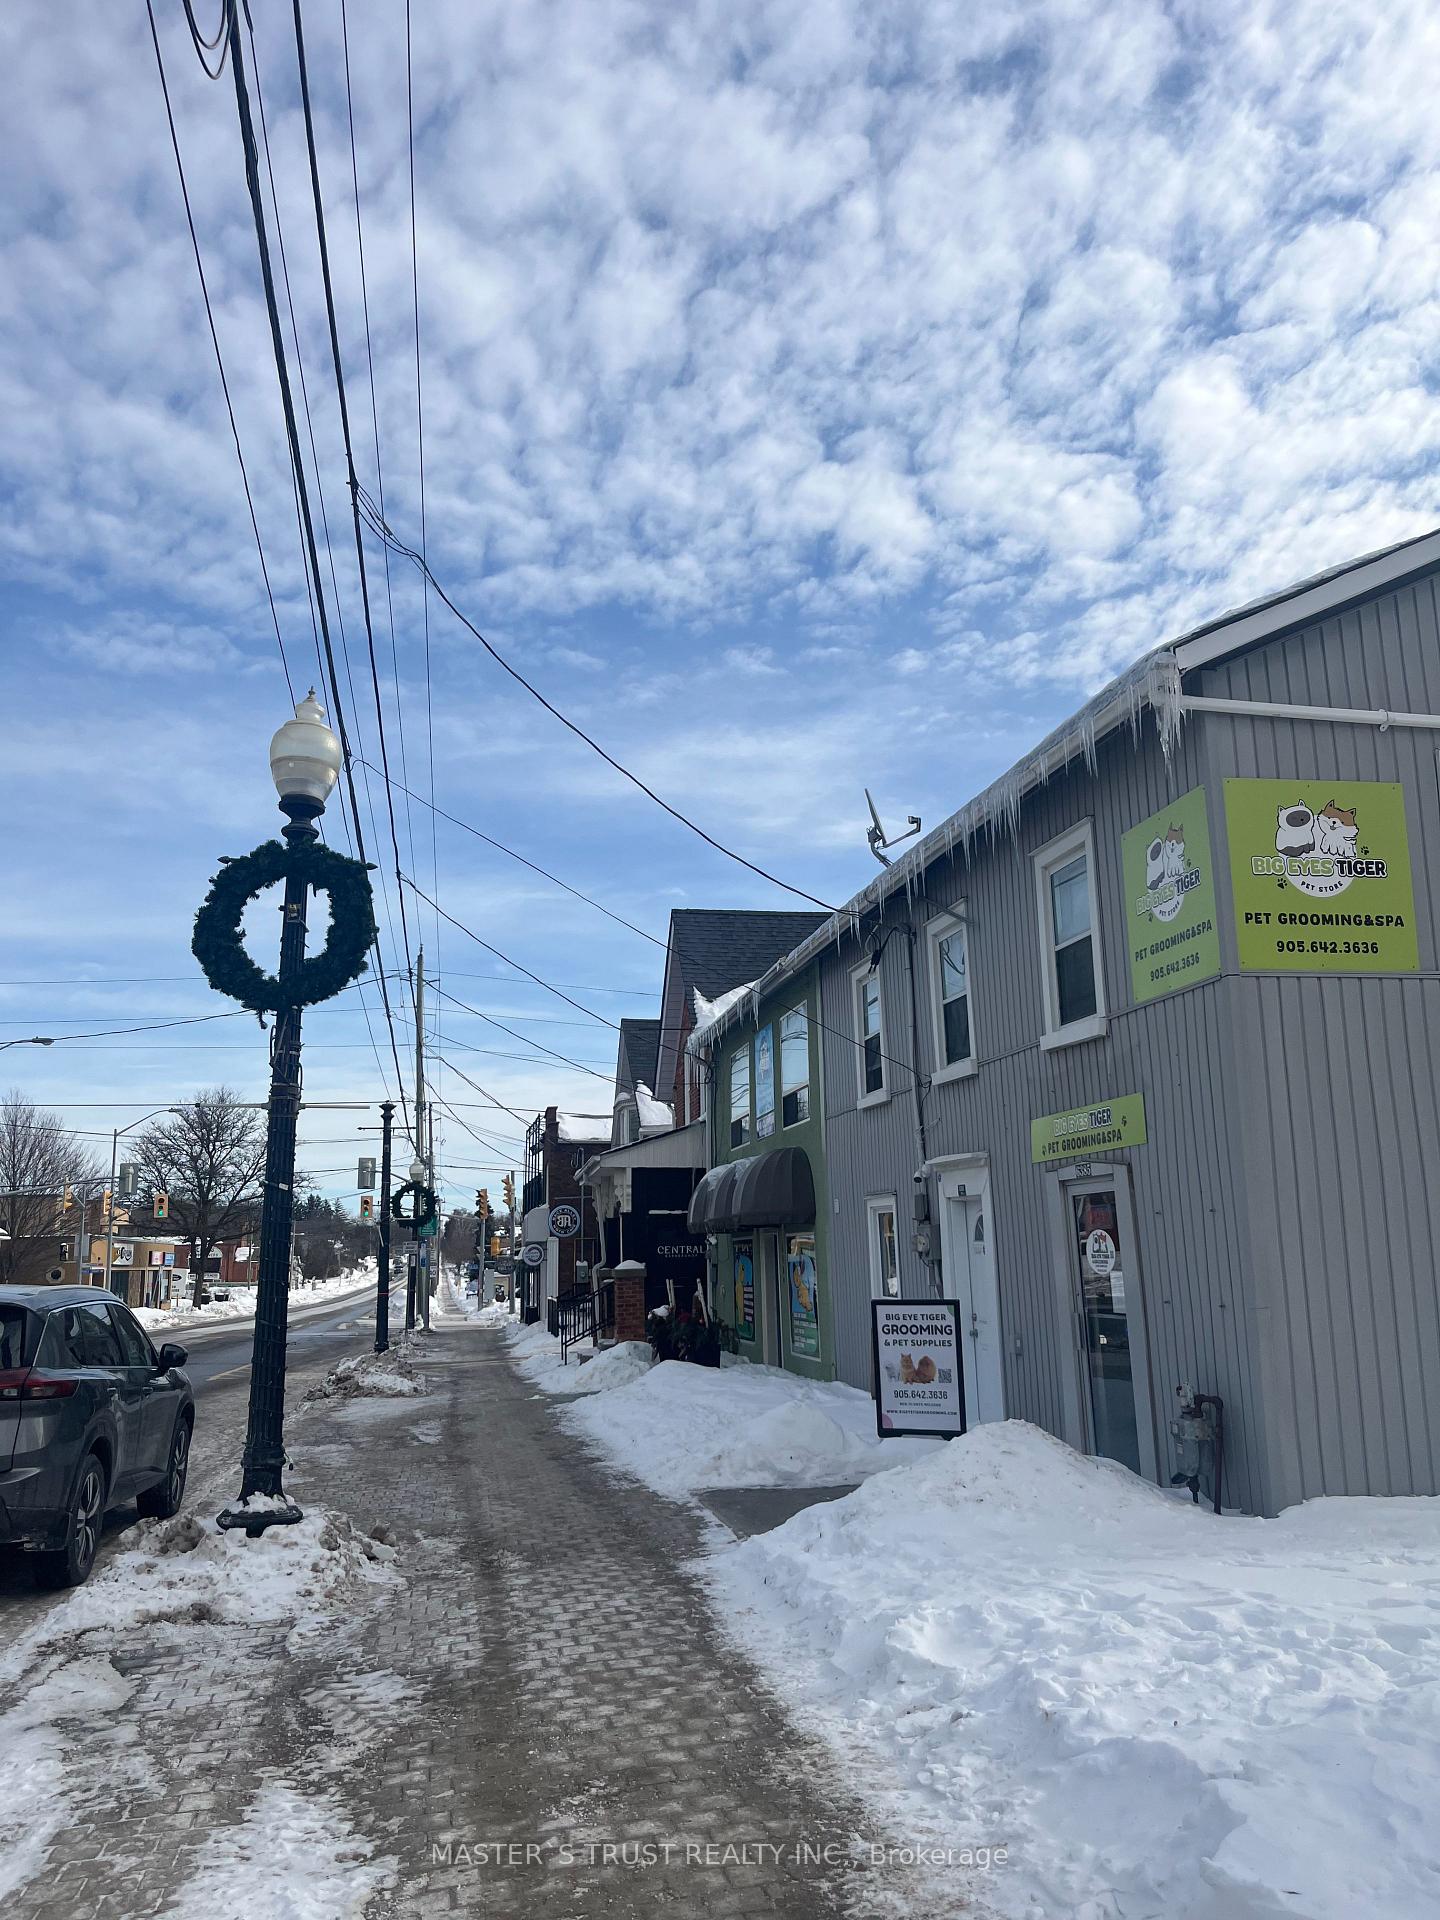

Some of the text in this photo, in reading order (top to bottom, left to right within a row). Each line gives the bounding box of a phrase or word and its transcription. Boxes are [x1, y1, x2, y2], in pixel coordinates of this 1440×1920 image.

[1252, 857, 1387, 878] BIG EYES TIGER
[1136, 867, 1201, 916] BIG EYES TIGER
[1301, 881, 1344, 892] PET STORE
[1245, 913, 1404, 927] PET GROOMING&SPA
[1135, 920, 1213, 962] PET GROOMING&SPA
[1276, 940, 1379, 954] 905.642.3636
[1150, 952, 1200, 982] 905.642.3636
[1054, 1107, 1112, 1137] BIG EYES TIGER
[1048, 1129, 1122, 1154] PET GROOMING&SPA
[657, 1245, 705, 1254] CENTRAL
[920, 1313, 946, 1321] TIGER
[882, 1324, 953, 1335] GROOMING
[884, 1339, 890, 1347] &
[910, 1339, 952, 1347] SUPPLIES
[893, 1390, 948, 1400] 905.642.3636
